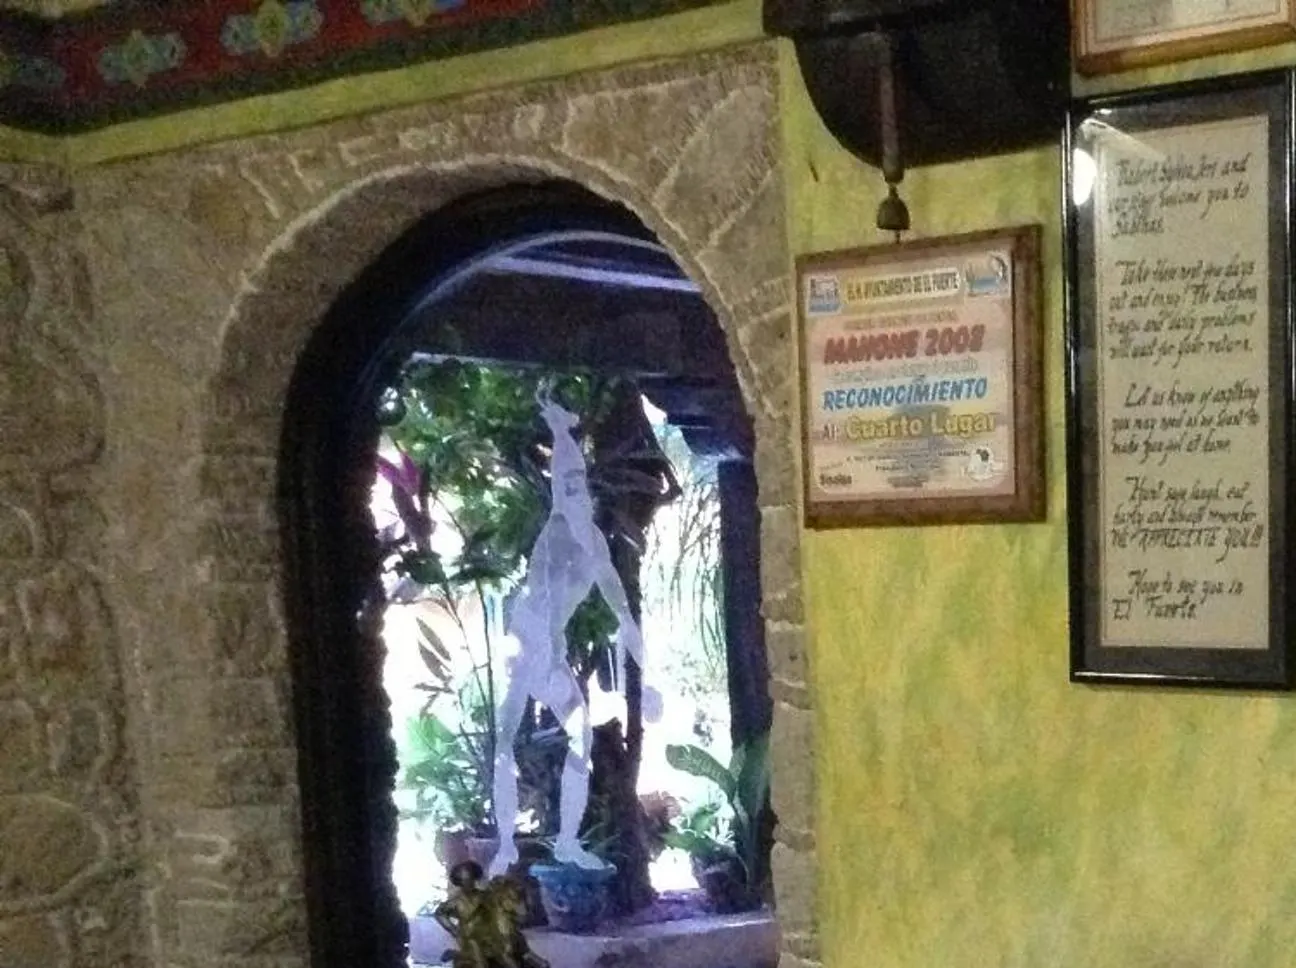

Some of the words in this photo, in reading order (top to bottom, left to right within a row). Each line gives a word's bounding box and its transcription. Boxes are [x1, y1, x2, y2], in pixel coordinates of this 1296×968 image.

[822, 377, 988, 412] RECONOCIMIENTO
[845, 414, 924, 442] Cuarto
[930, 410, 998, 442] Lugar
